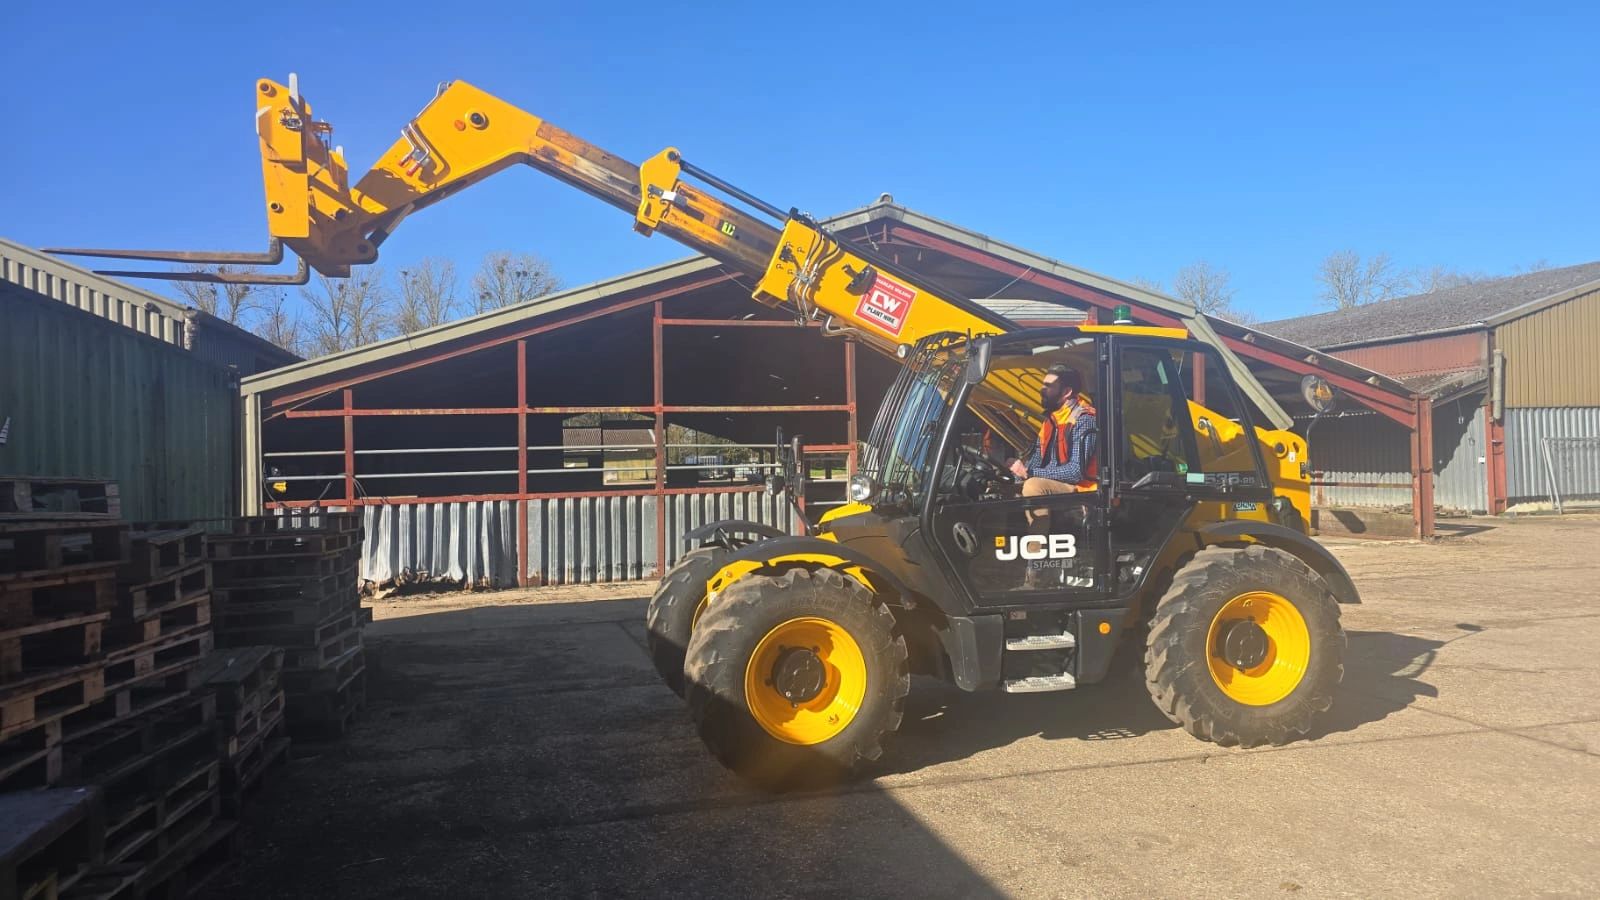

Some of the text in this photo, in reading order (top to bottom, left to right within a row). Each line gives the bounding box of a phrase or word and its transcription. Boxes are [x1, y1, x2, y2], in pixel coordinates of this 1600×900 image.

[870, 290, 901, 313] CW
[867, 306, 895, 324] PLANT HIRE
[995, 534, 1077, 560] JCB
[1033, 560, 1061, 569] STAGE
